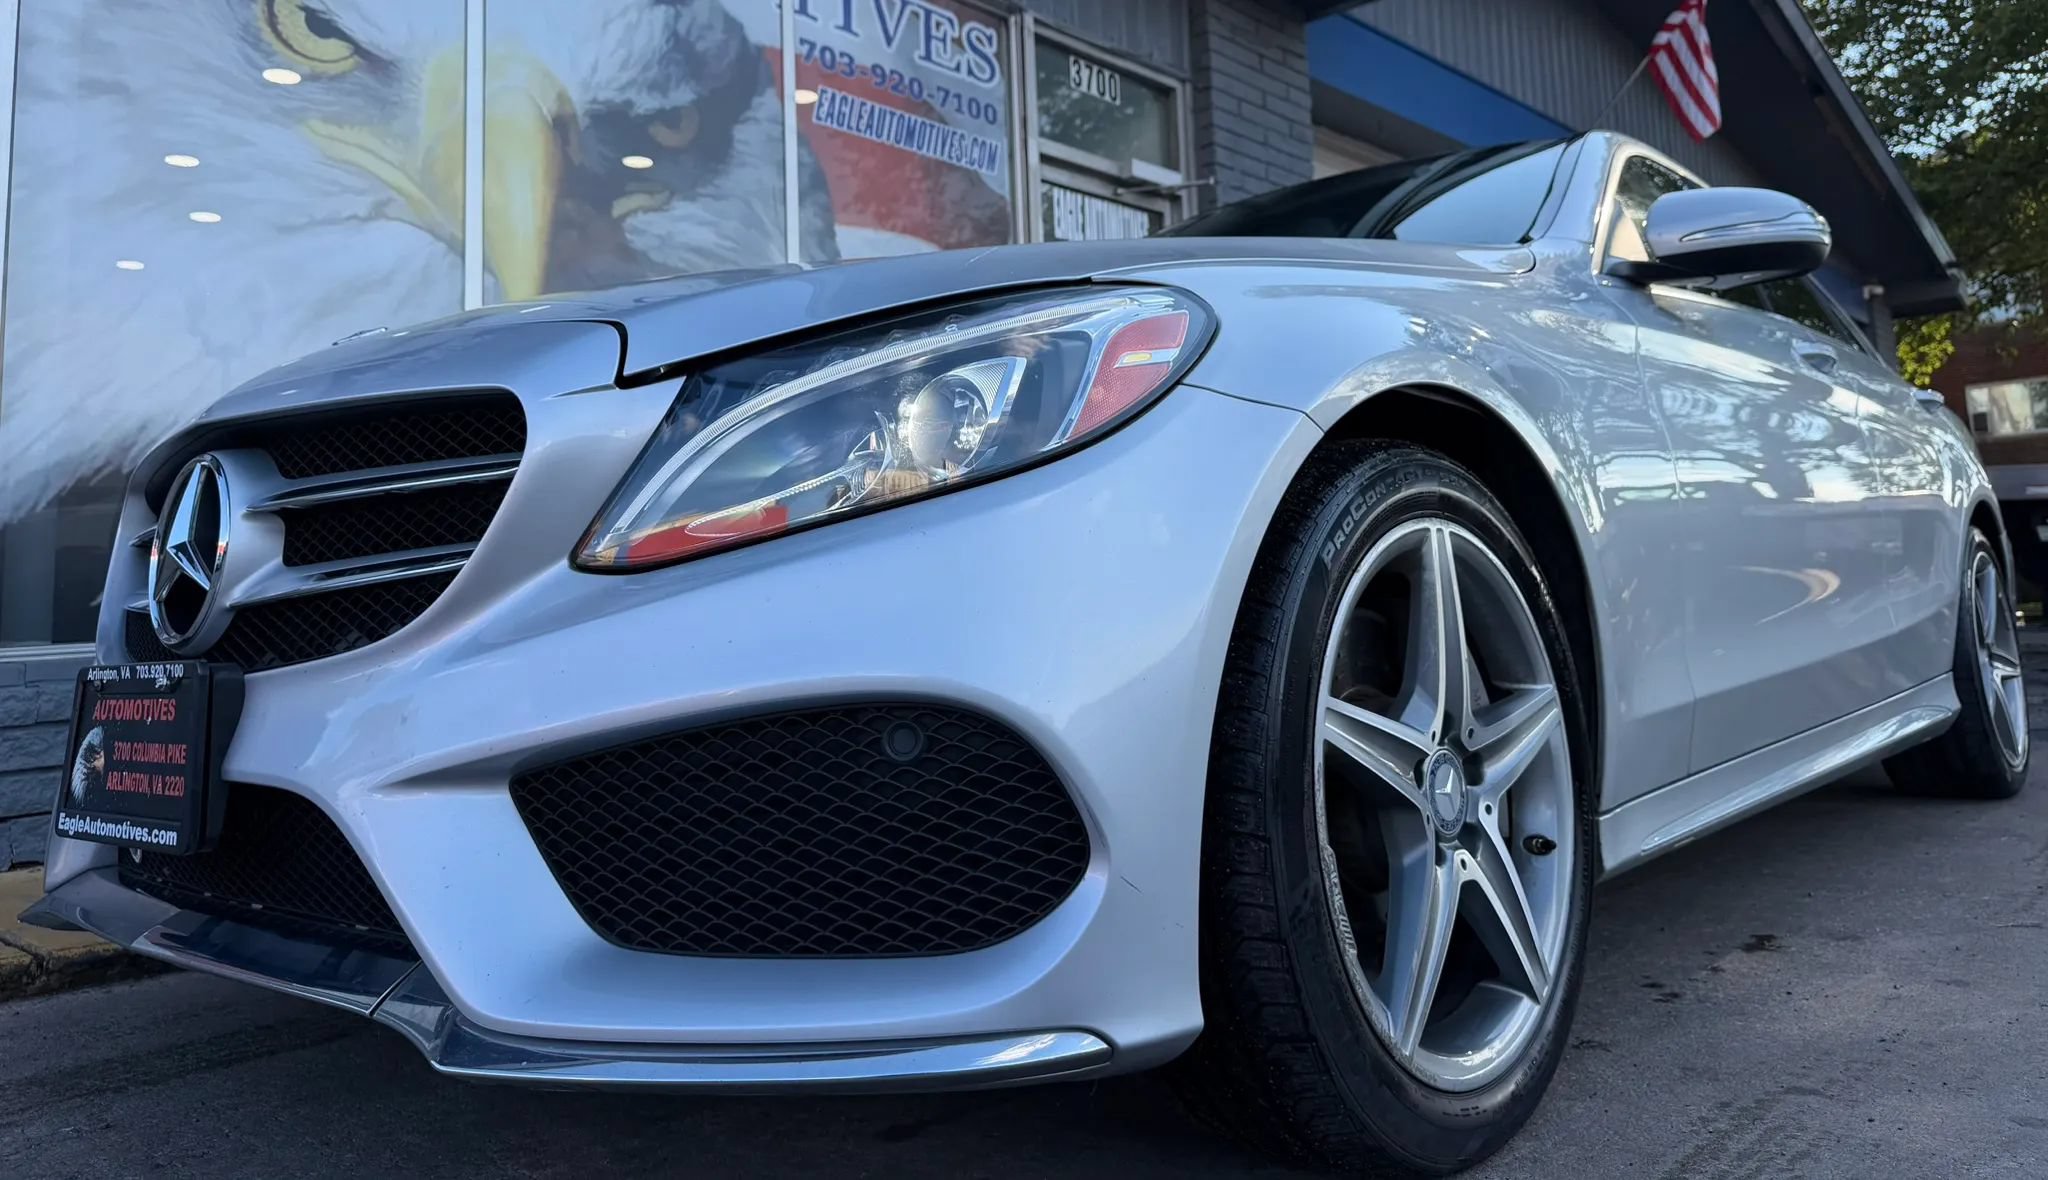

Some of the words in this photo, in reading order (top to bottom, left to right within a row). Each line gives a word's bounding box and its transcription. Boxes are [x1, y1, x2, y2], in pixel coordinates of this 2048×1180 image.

[799, 37, 998, 125] 703-920-7100
[1071, 58, 1119, 103] 3700
[815, 87, 999, 173] EAGLEAUTOMOTIVES.COM
[87, 667, 120, 683] Arlington,
[120, 666, 131, 679] VA
[92, 698, 176, 721] AUTOMOTIVES
[113, 741, 131, 761] 3700
[132, 742, 166, 763] COLUMBIA
[167, 744, 187, 765] PIKE
[106, 771, 150, 795] ARLINGTON,
[152, 775, 162, 795] VA
[58, 812, 178, 846] EagleAutomotives.com
